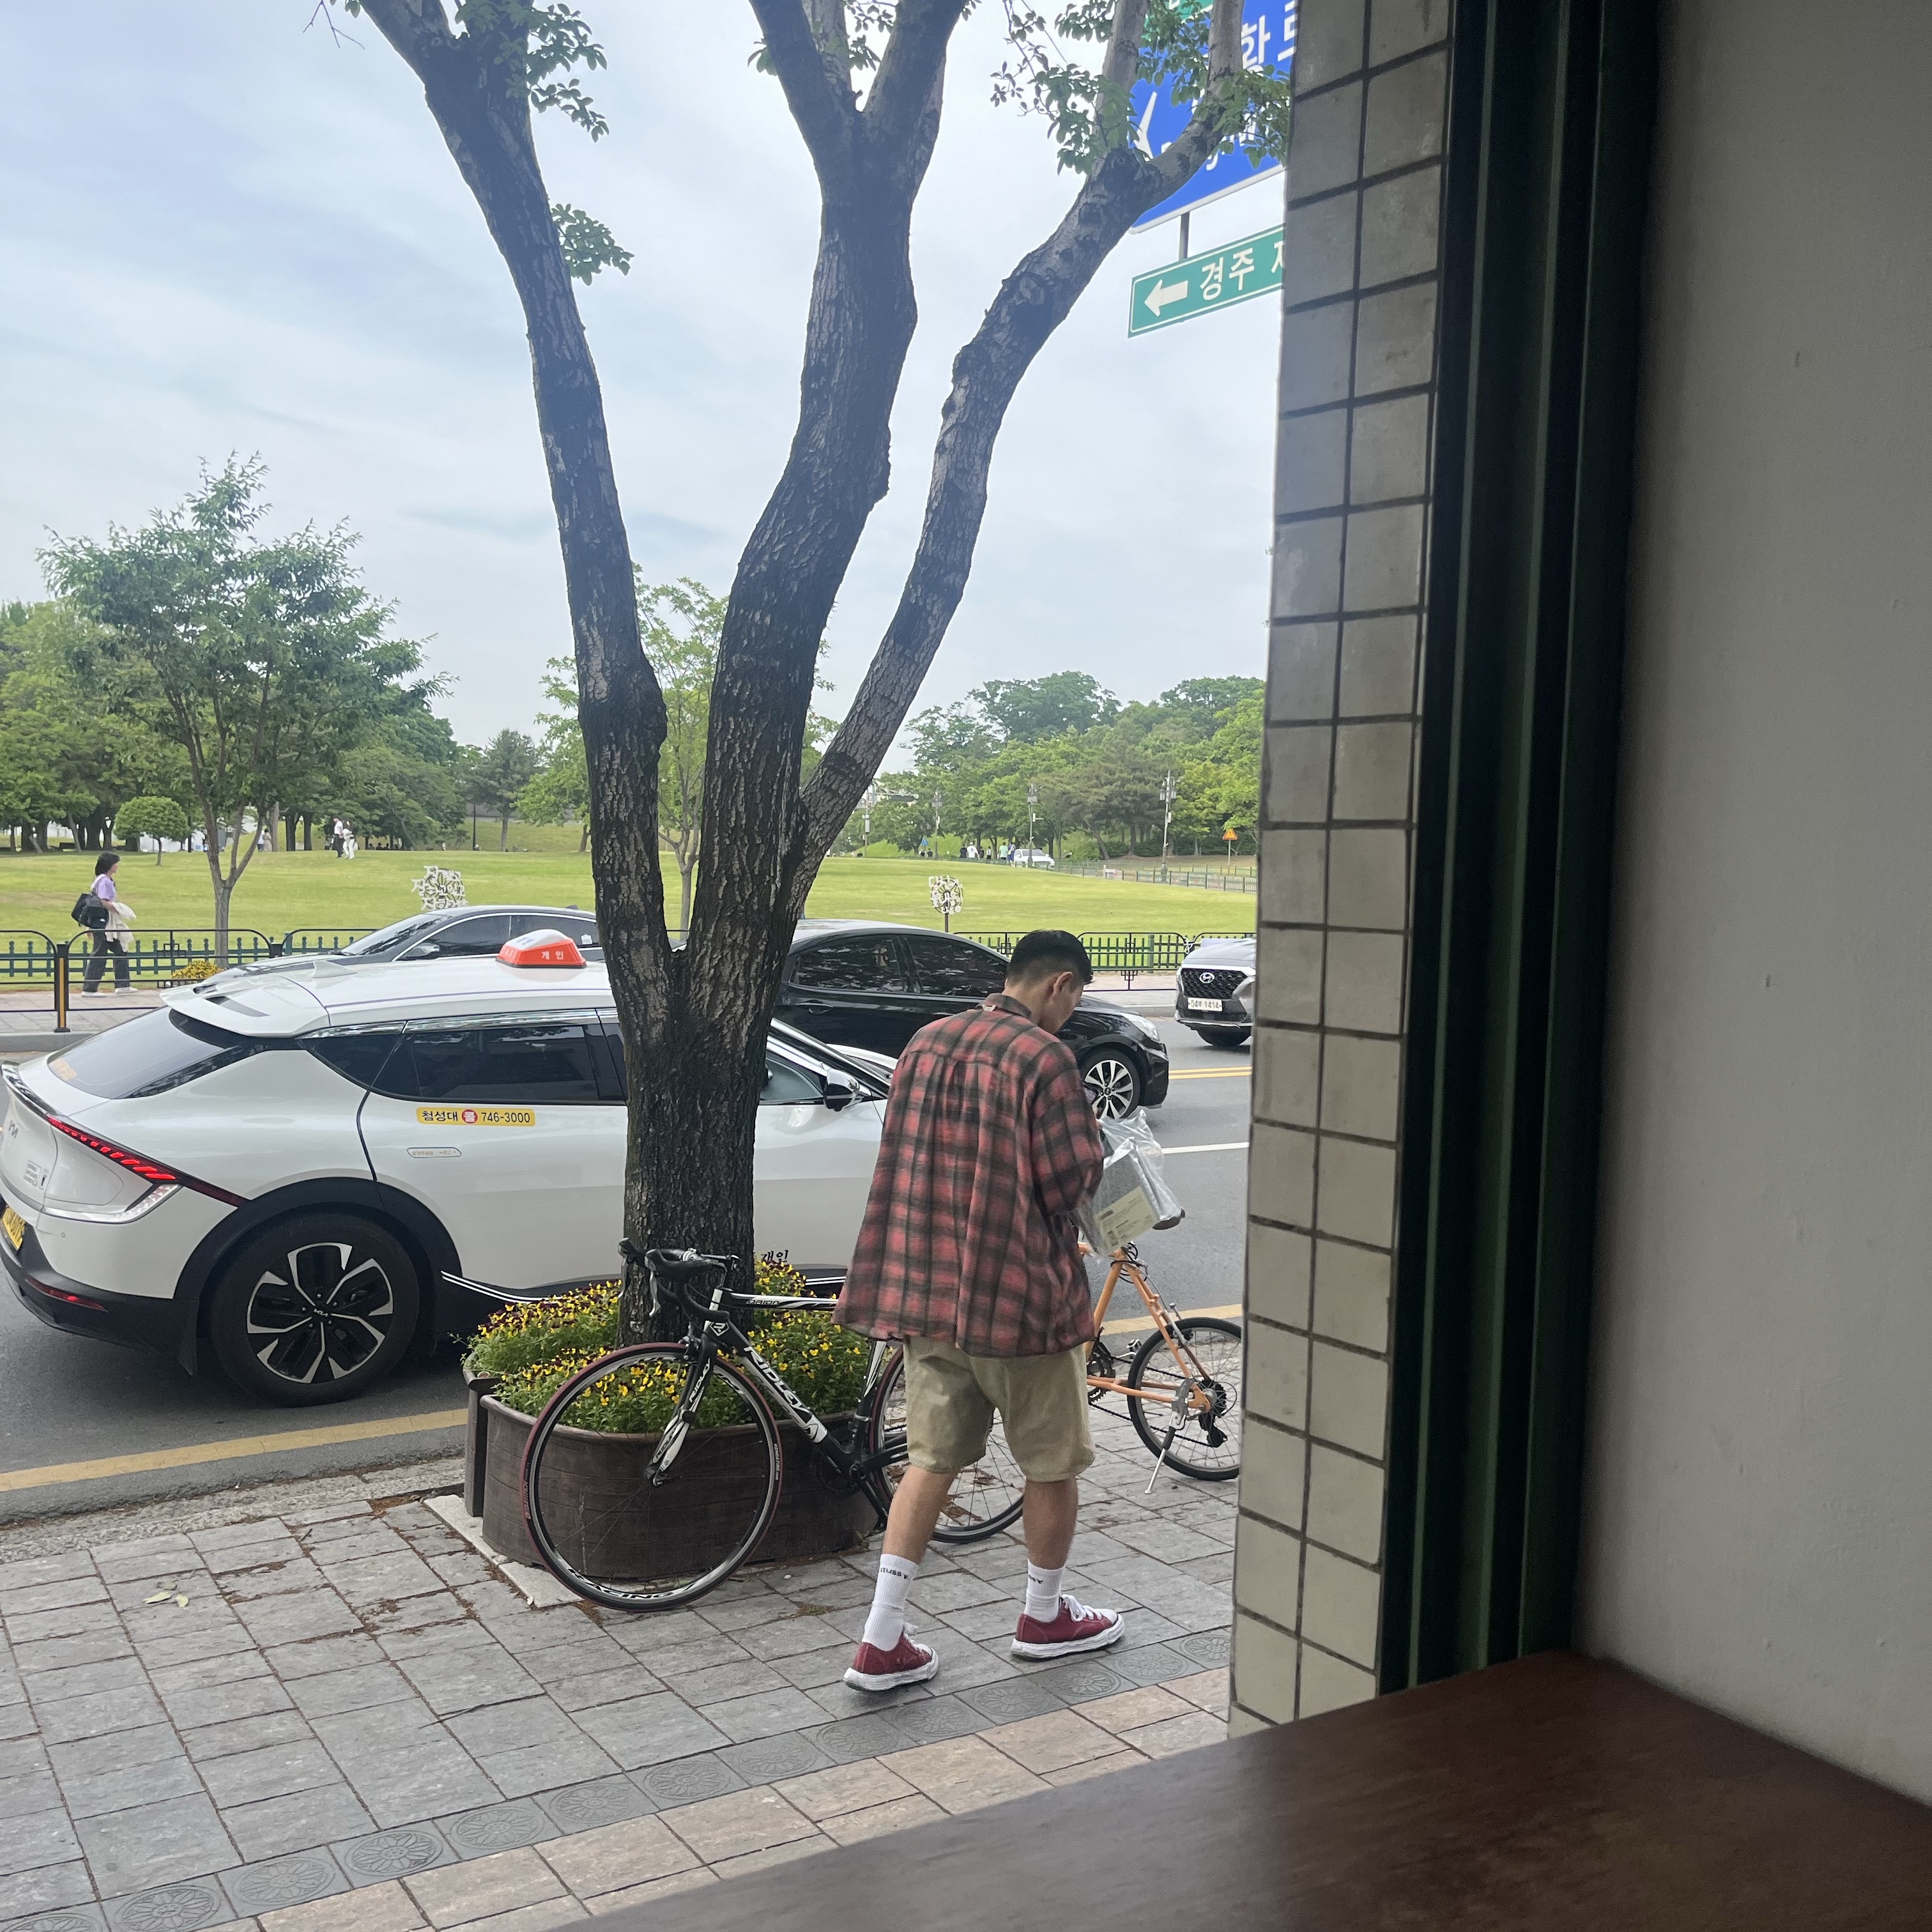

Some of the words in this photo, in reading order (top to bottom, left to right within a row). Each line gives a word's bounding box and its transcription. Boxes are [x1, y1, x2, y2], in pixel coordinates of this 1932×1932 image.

[1200, 247, 1254, 301] 경주
[422, 1110, 458, 1122] 첨성대
[481, 1112, 530, 1123] 746-3000
[761, 1250, 788, 1263] 개인
[744, 1346, 811, 1413] RIDLEY
